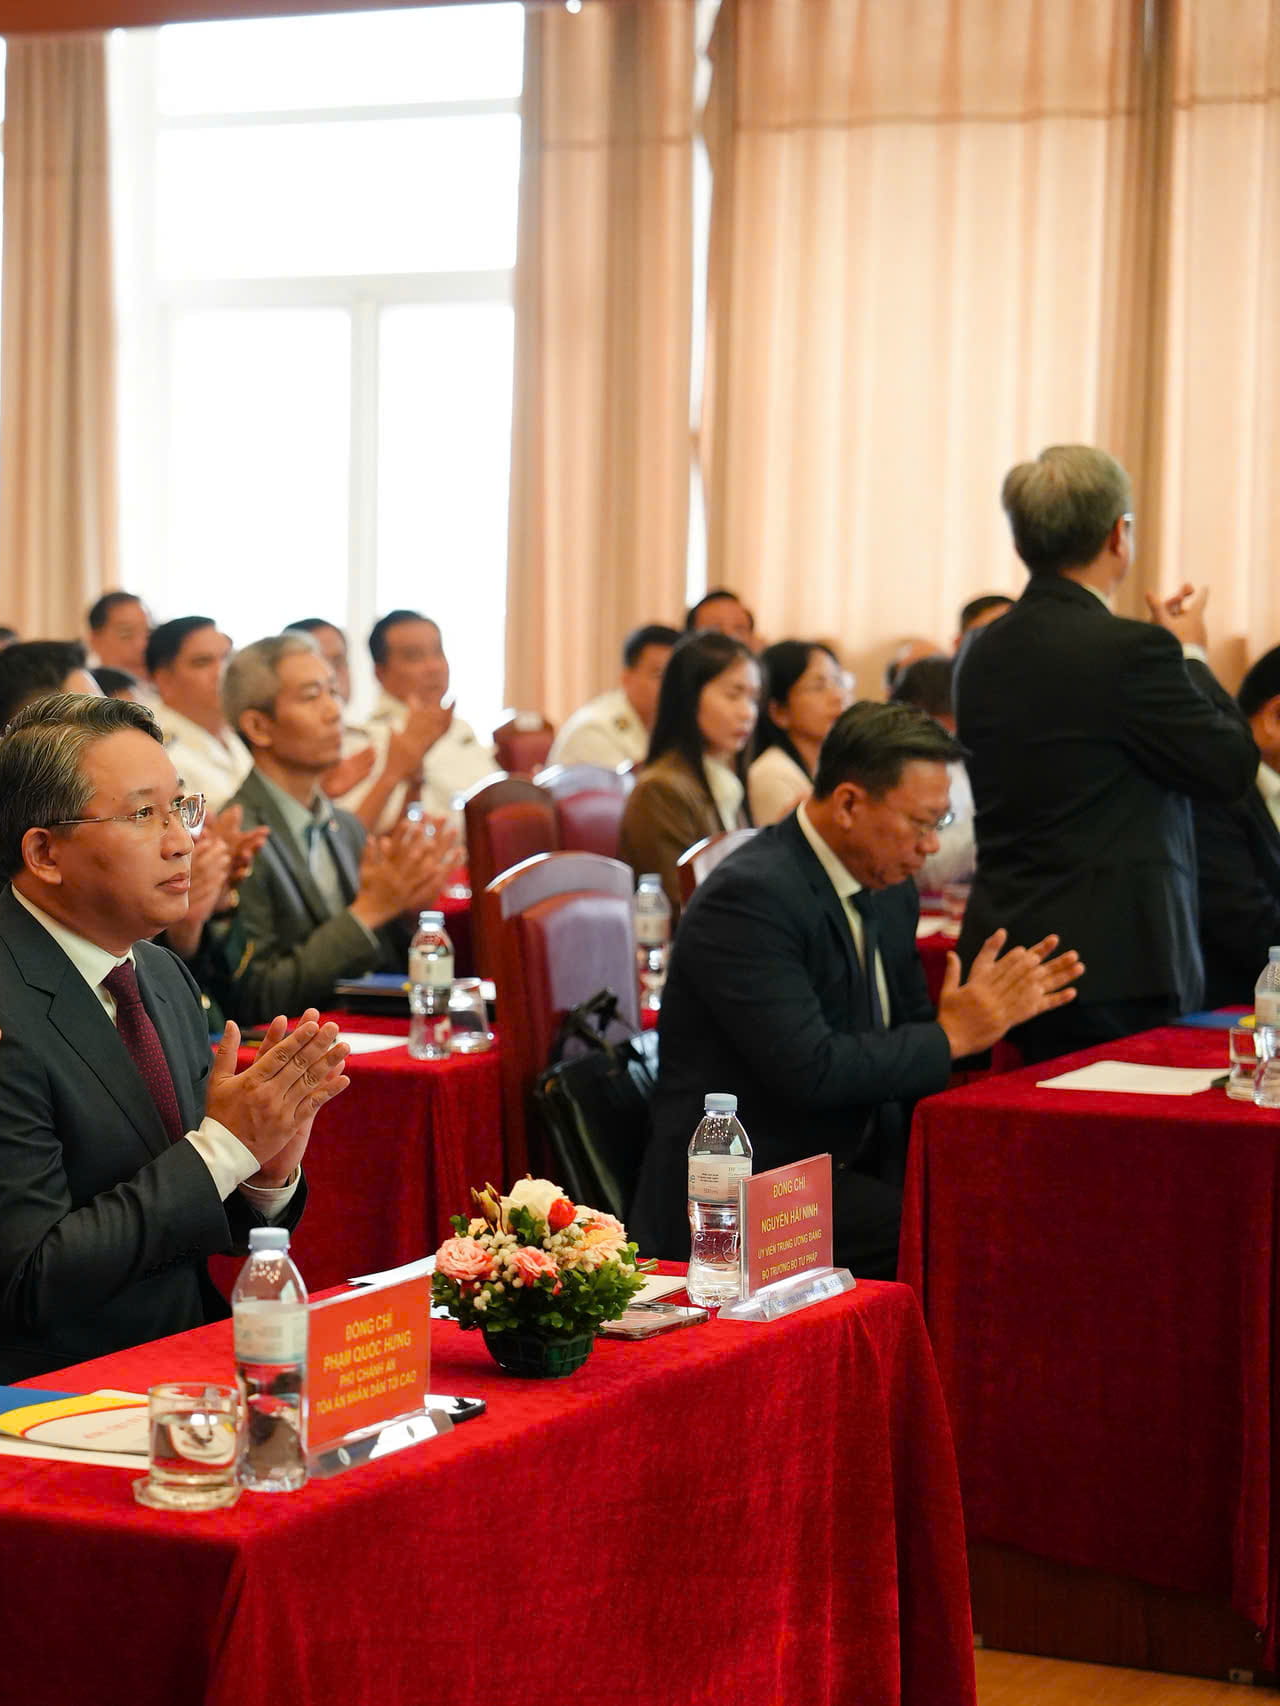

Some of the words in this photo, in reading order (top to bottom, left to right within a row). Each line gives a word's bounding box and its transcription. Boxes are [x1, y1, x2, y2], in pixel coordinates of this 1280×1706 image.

[794, 1174, 806, 1192] CHÍ
[802, 1203, 818, 1221] NINH
[375, 1307, 393, 1331] CHÍ
[400, 1370, 417, 1386] CAO
